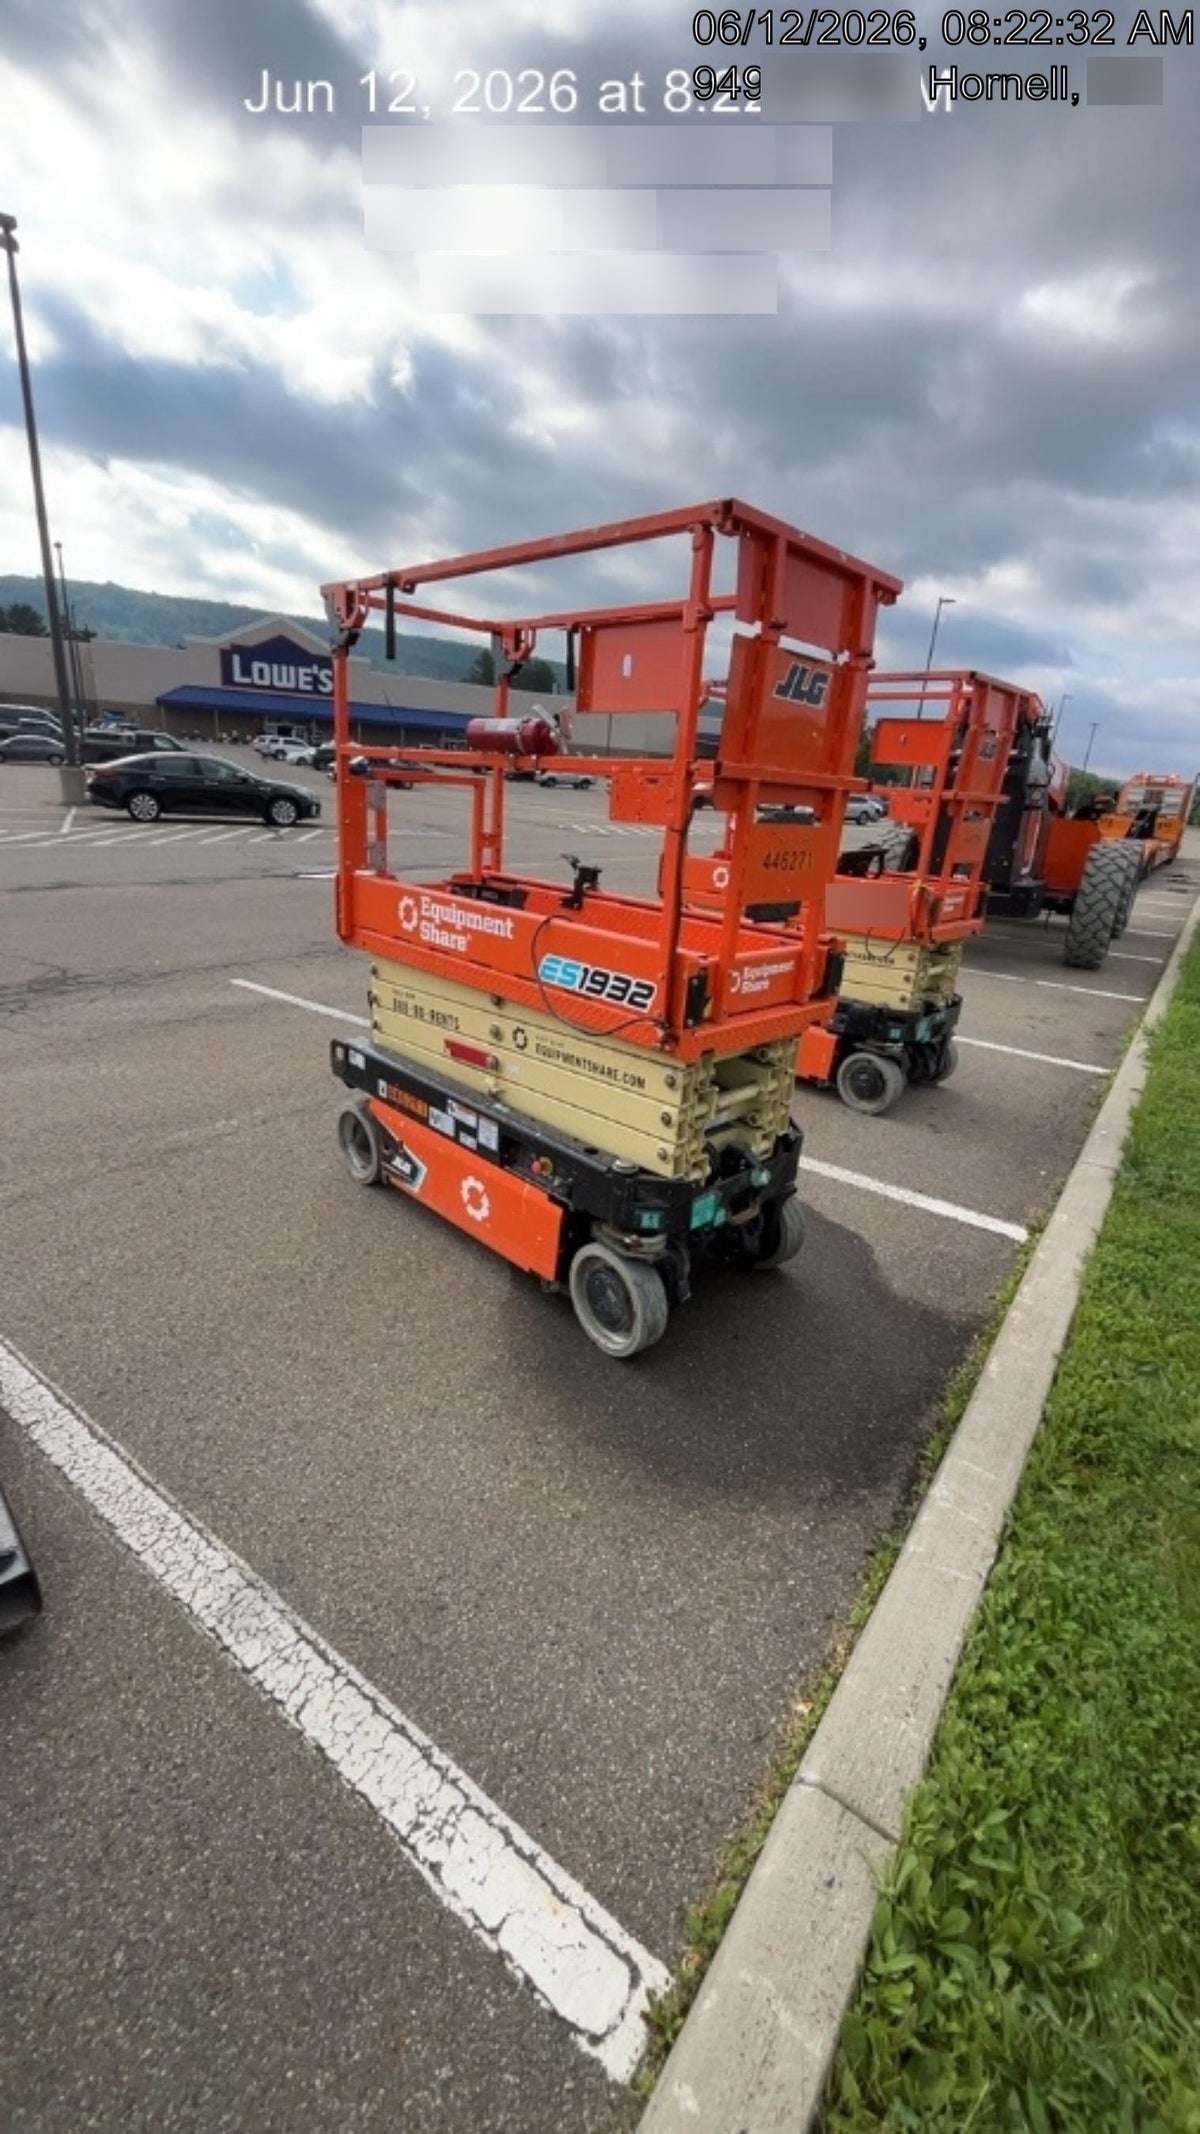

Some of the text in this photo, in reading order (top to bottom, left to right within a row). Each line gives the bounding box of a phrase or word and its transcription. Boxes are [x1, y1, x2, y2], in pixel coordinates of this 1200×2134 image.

[231, 653, 334, 693] LOWE'S
[773, 661, 832, 709] JLG
[762, 850, 814, 871] 446271
[419, 896, 514, 940] Equipment
[540, 955, 655, 1011] ES1932
